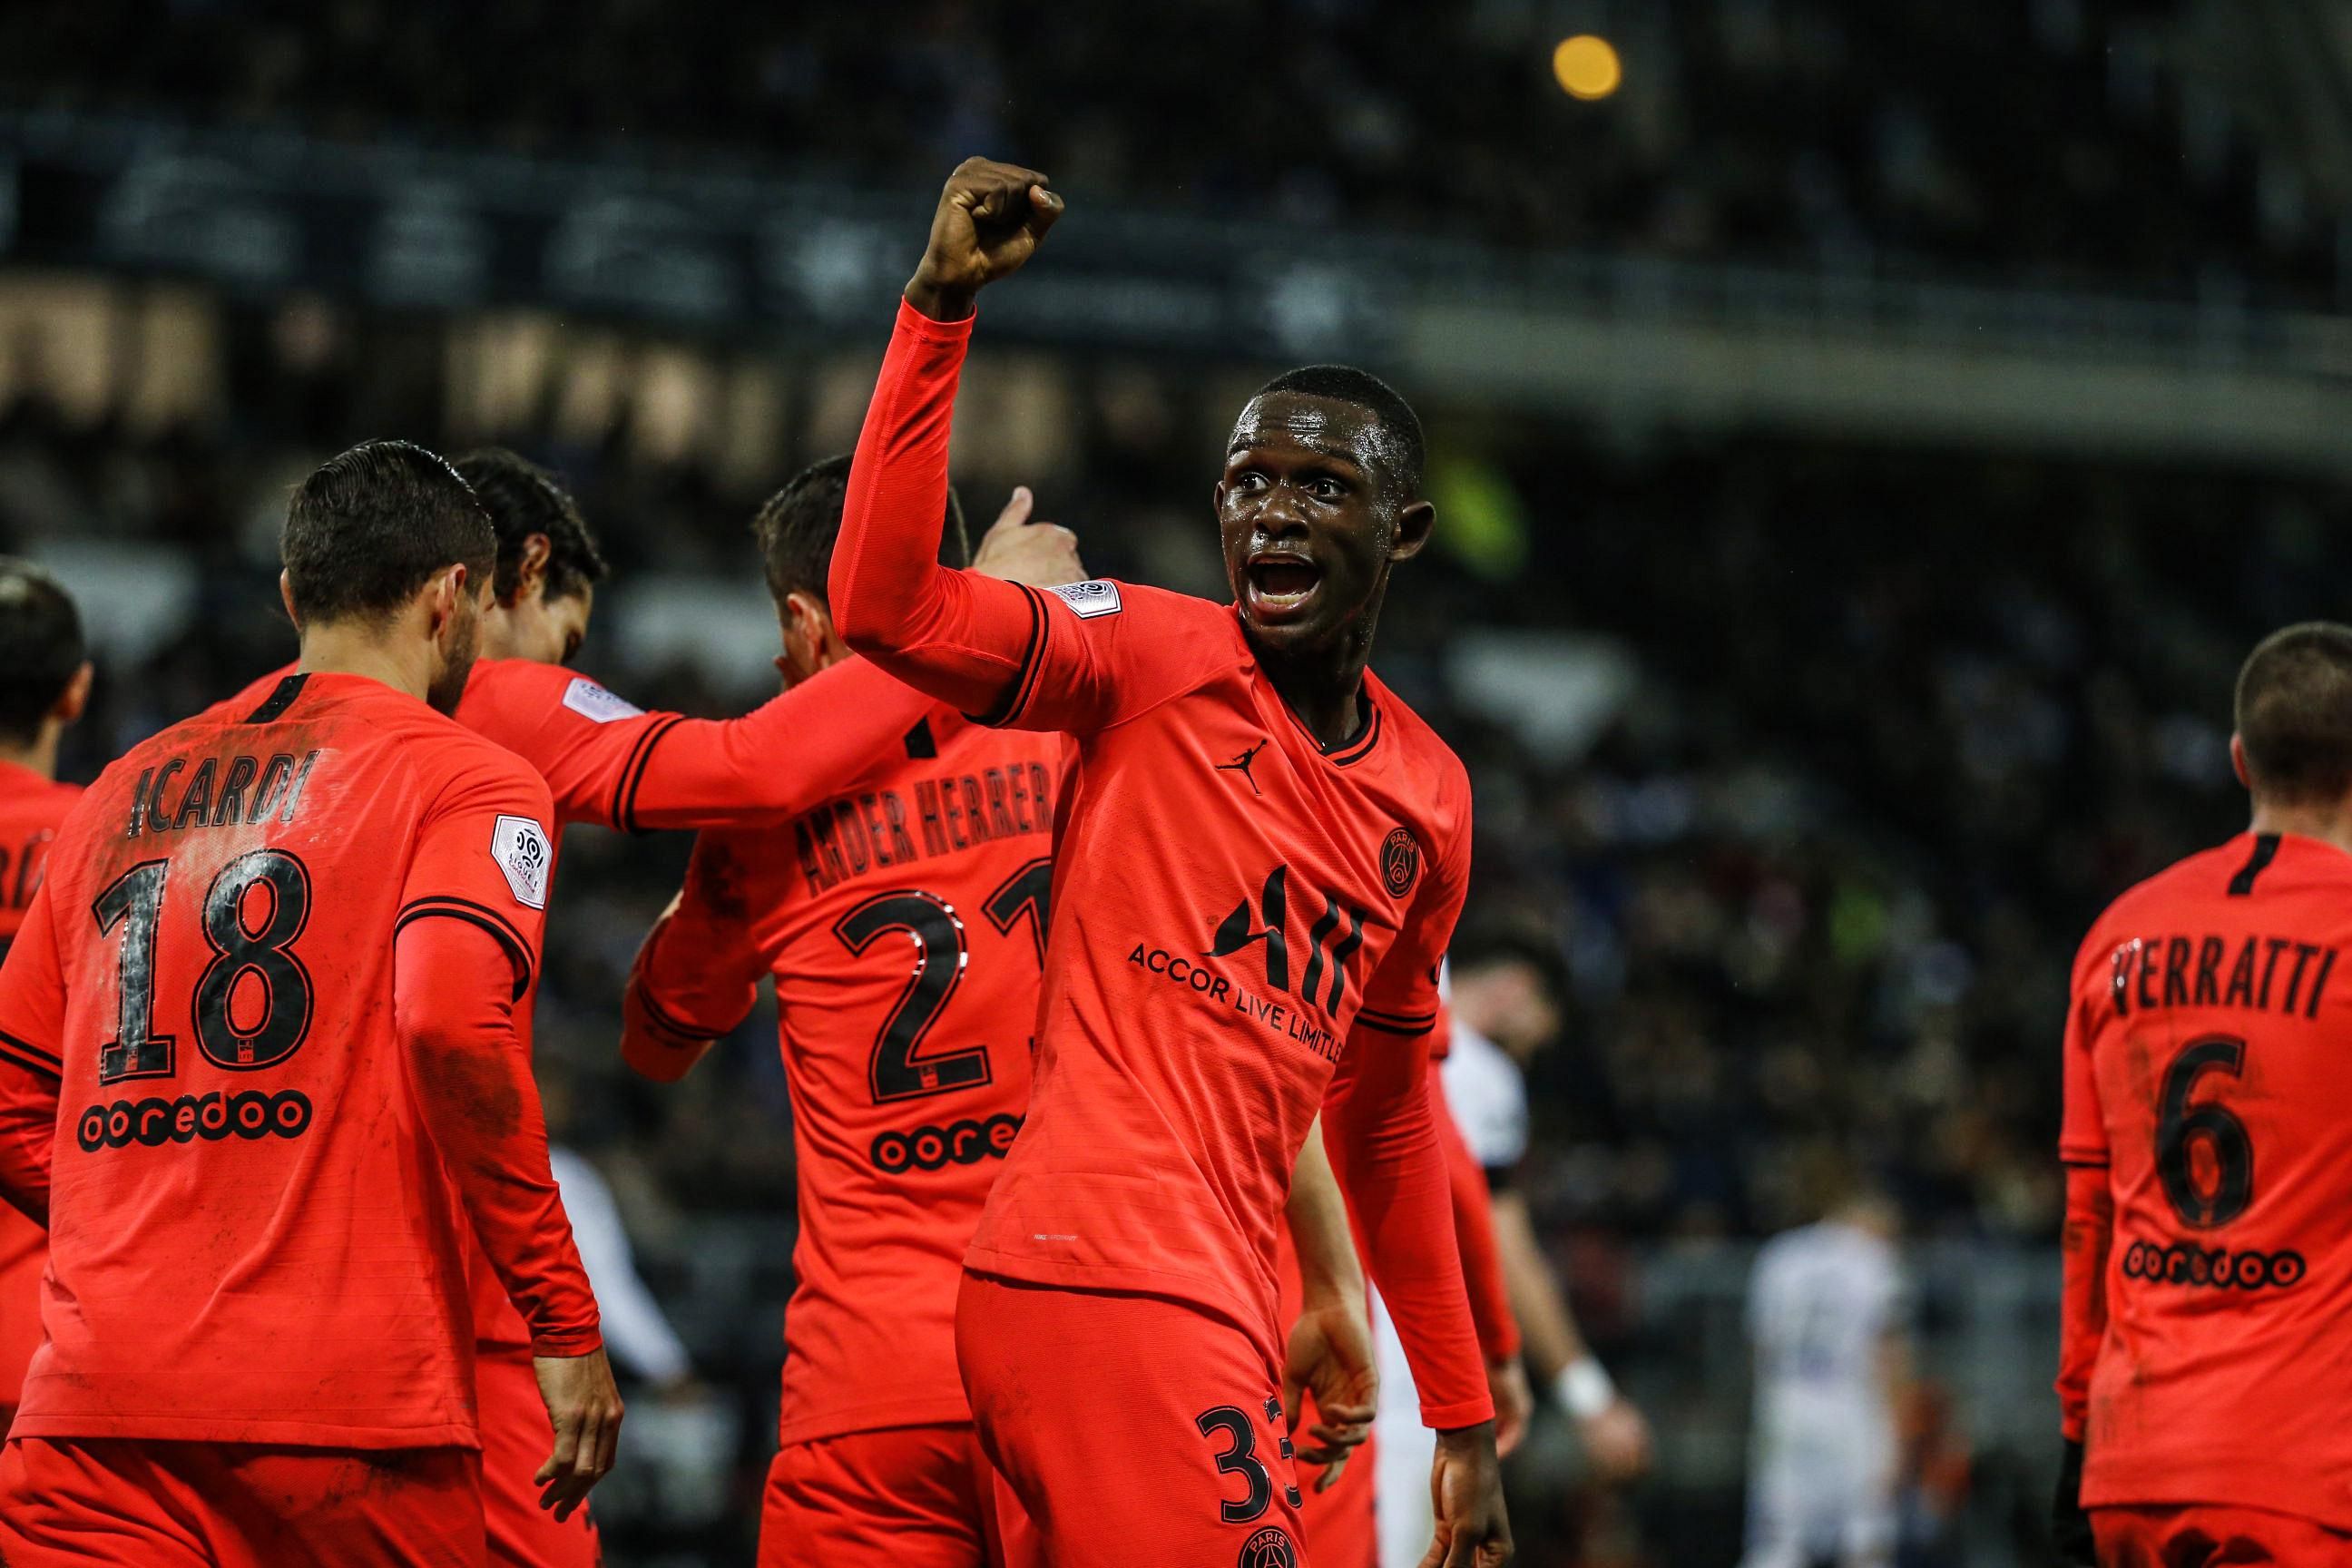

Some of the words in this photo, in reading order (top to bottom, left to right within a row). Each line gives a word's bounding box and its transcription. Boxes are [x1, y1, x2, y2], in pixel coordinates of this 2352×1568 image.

[128, 748, 320, 839] ICARDI
[793, 791, 918, 898] ANDER
[914, 760, 1063, 858] HERRER
[1390, 833, 1416, 853] PARIS
[92, 848, 314, 1086] 18
[1128, 943, 1230, 1003] ACCOR
[1235, 987, 1285, 1031] LIVE
[1289, 1014, 1346, 1065] LIMITLE
[2110, 936, 2337, 1019] VERRATTI
[78, 1091, 312, 1152] ooredoo
[871, 1112, 1028, 1174] oore
[2156, 1034, 2254, 1230] 6
[1250, 1533, 1285, 1552] PARIS
